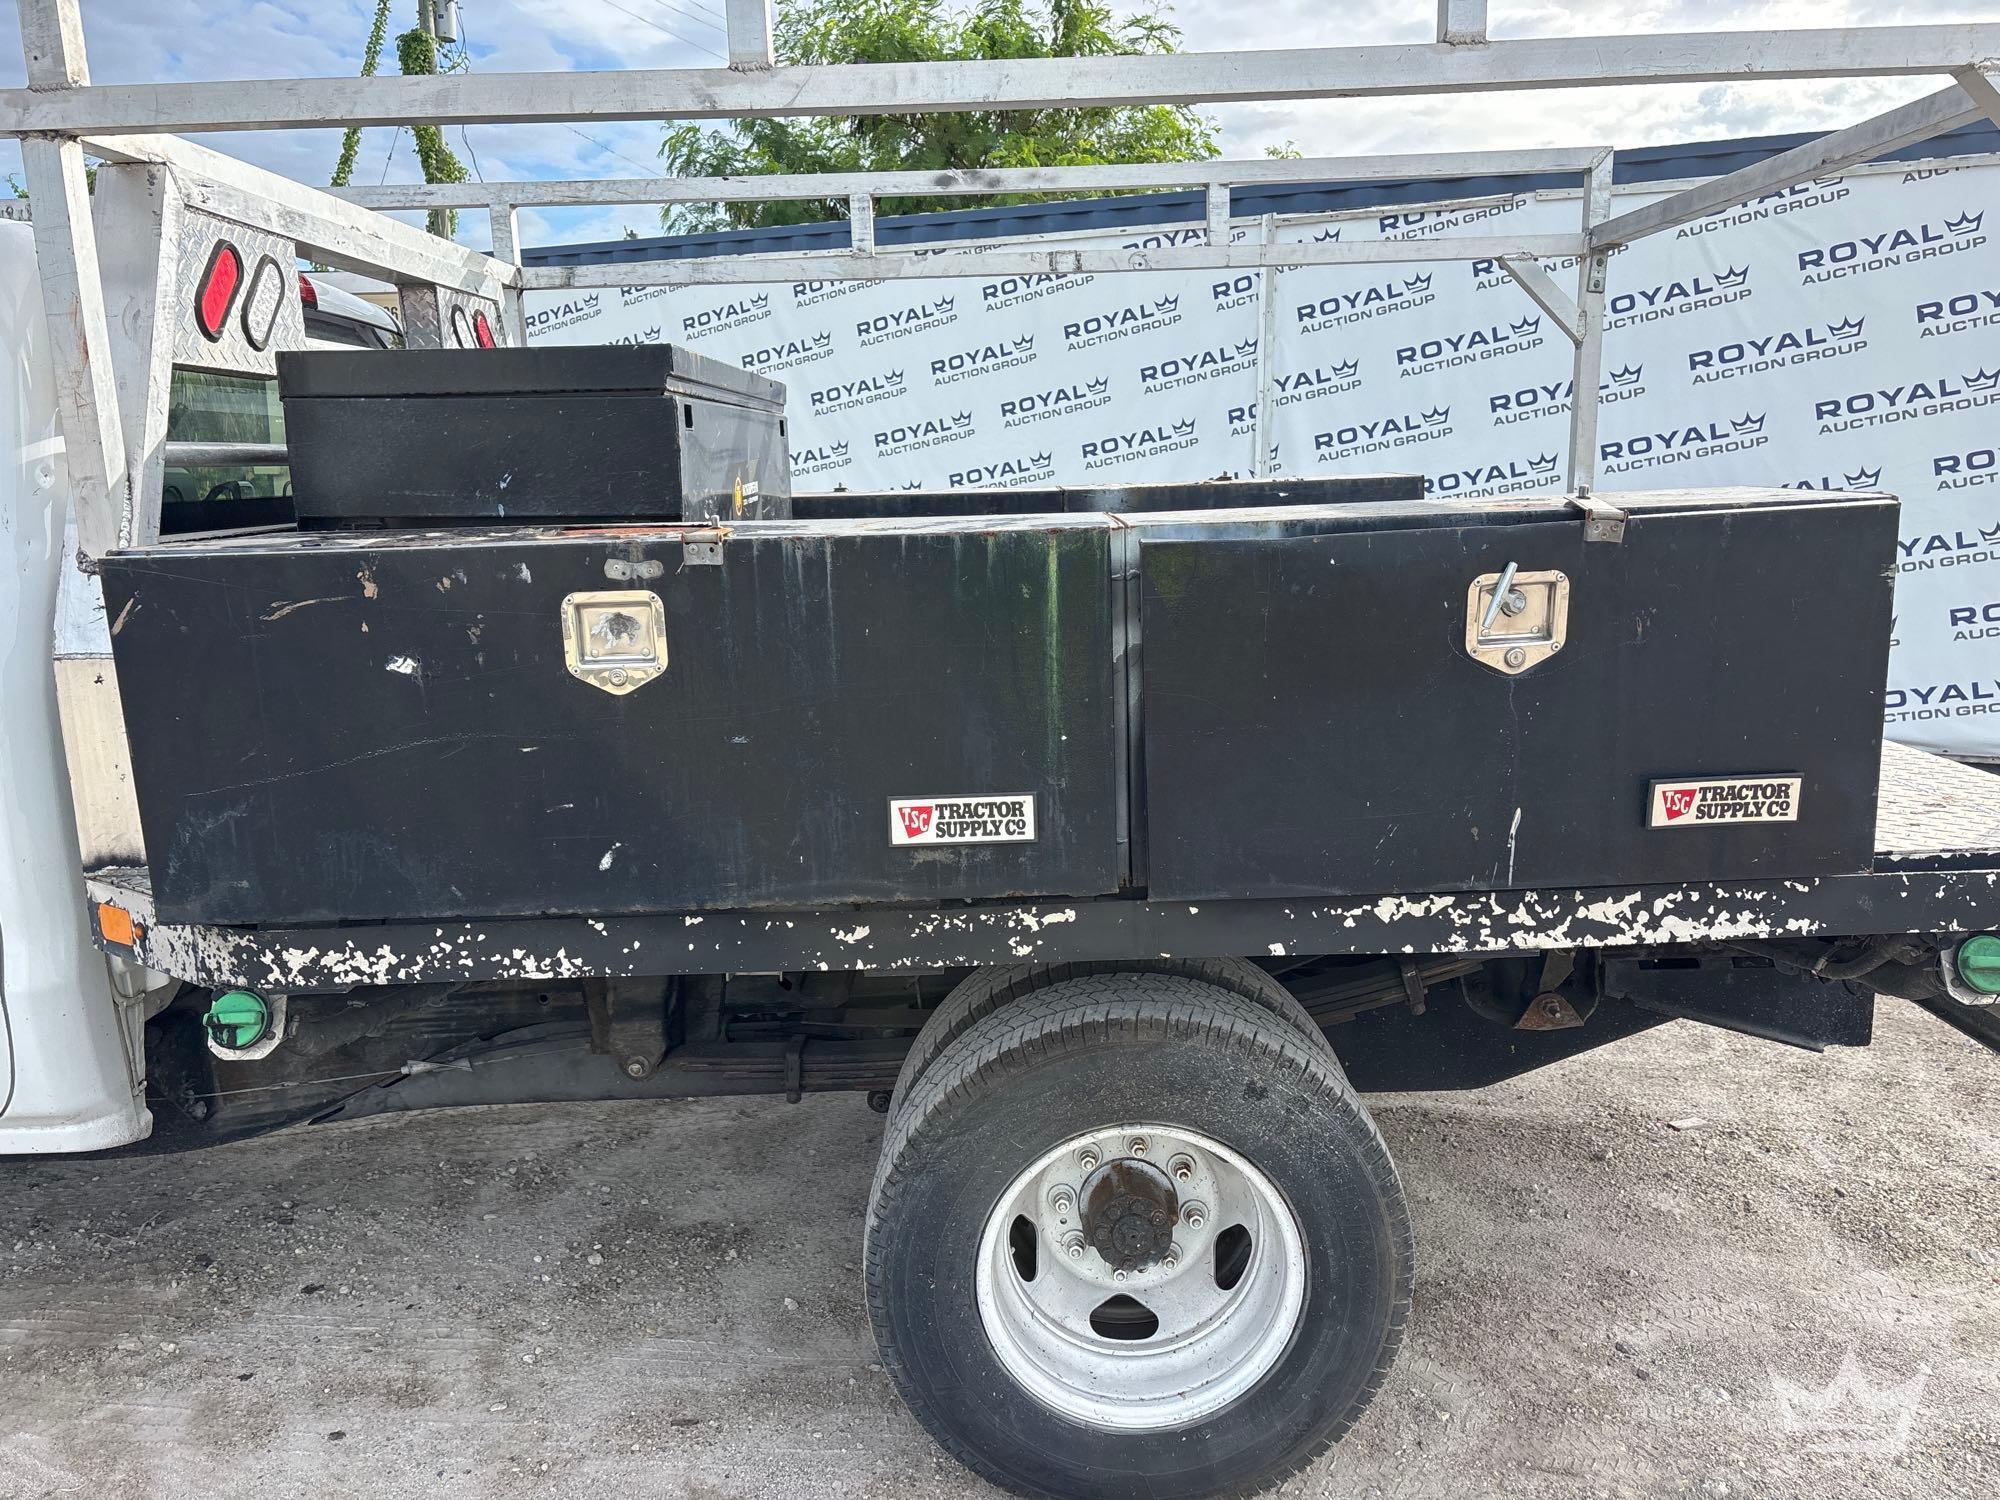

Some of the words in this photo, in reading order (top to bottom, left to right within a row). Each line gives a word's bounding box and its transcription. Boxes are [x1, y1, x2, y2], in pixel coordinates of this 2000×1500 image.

[1462, 199, 1527, 224] GROUP
[1676, 208, 1769, 240] AUCTION
[1773, 188, 1850, 215] GROUP
[1798, 224, 1944, 271] ROYAL
[1802, 255, 1901, 286] AUCTION
[1905, 236, 1987, 262] GROUP
[796, 287, 846, 309] AUCTION
[986, 289, 1044, 312] AUCTION
[1046, 275, 1094, 295] GROUP
[1297, 283, 1404, 322] ROYAL
[1610, 277, 1714, 314] OYAL
[1679, 288, 1752, 314] GROUP
[524, 301, 584, 329] ROYAL
[528, 320, 568, 338] AUCTION
[569, 308, 602, 325] GROUP
[683, 301, 751, 331] ROYAL
[686, 321, 732, 341] AUCTION
[733, 310, 772, 327] GROUP
[856, 305, 934, 337] ROYAL
[1063, 304, 1155, 340] ROYAL
[1300, 309, 1372, 335] AUCTION
[1376, 293, 1435, 316] GROUP
[1920, 313, 2000, 338] AUCTIO
[860, 326, 912, 348] AUCTION
[914, 314, 958, 333] GROUP
[1067, 328, 1128, 352] AUCTION
[1131, 314, 1182, 335] GROUP
[1396, 326, 1510, 365] ROYAL
[741, 339, 813, 369] ROYAL
[794, 348, 834, 366] GROUP
[931, 343, 1013, 375] ROYAL
[1400, 353, 1476, 378] AUCTION
[1480, 337, 1544, 360] GROUP
[1688, 328, 1827, 371] ROYAL
[1692, 357, 1786, 385] AUCTION
[1790, 340, 1868, 365] GROUP
[934, 365, 990, 386] AUCTION
[991, 353, 1037, 372] GROUP
[1140, 347, 1235, 383] ROYAL
[810, 377, 885, 406] ROYAL
[1144, 371, 1208, 395] AUCTION
[1305, 379, 1362, 400] GROUP
[814, 398, 864, 417] AUCTION
[865, 387, 907, 404] GROUP
[1000, 385, 1087, 417] ROYAL
[1004, 408, 1062, 429] AUCTION
[1064, 395, 1112, 414] GROUP
[1815, 378, 1962, 421] ROYAL
[874, 418, 952, 447] ROYAL
[1314, 415, 1421, 450] ROYAL
[1819, 408, 1918, 435] AUCTION
[790, 447, 831, 466] YAL
[878, 439, 931, 458] AUCTION
[932, 428, 975, 446] GROUP
[1082, 427, 1172, 459] ROYAL
[1085, 449, 1146, 470] AUCTION
[1149, 437, 1199, 456] GROUP
[1318, 440, 1390, 463] AUCTION
[1393, 427, 1453, 447] GROUP
[1600, 423, 1730, 461] ROYAL
[1604, 450, 1691, 475] AUCTION
[1695, 436, 1769, 458] GROUP
[812, 457, 852, 473] GROUP
[949, 459, 1030, 488] ROYAL
[1009, 470, 1055, 487] GROUP
[1498, 475, 1561, 494] GROUP
[1897, 531, 1978, 556] YAL
[1885, 682, 1994, 708] OYAL
[1884, 707, 1951, 723] CTION
[1666, 791, 1690, 813] TSC
[1699, 783, 1791, 802] TRACTOR
[902, 808, 928, 831] TSC
[935, 802, 1025, 820] TRACTOR
[1696, 801, 1766, 819] SUPPLY
[936, 820, 1003, 838] SUPPLY
